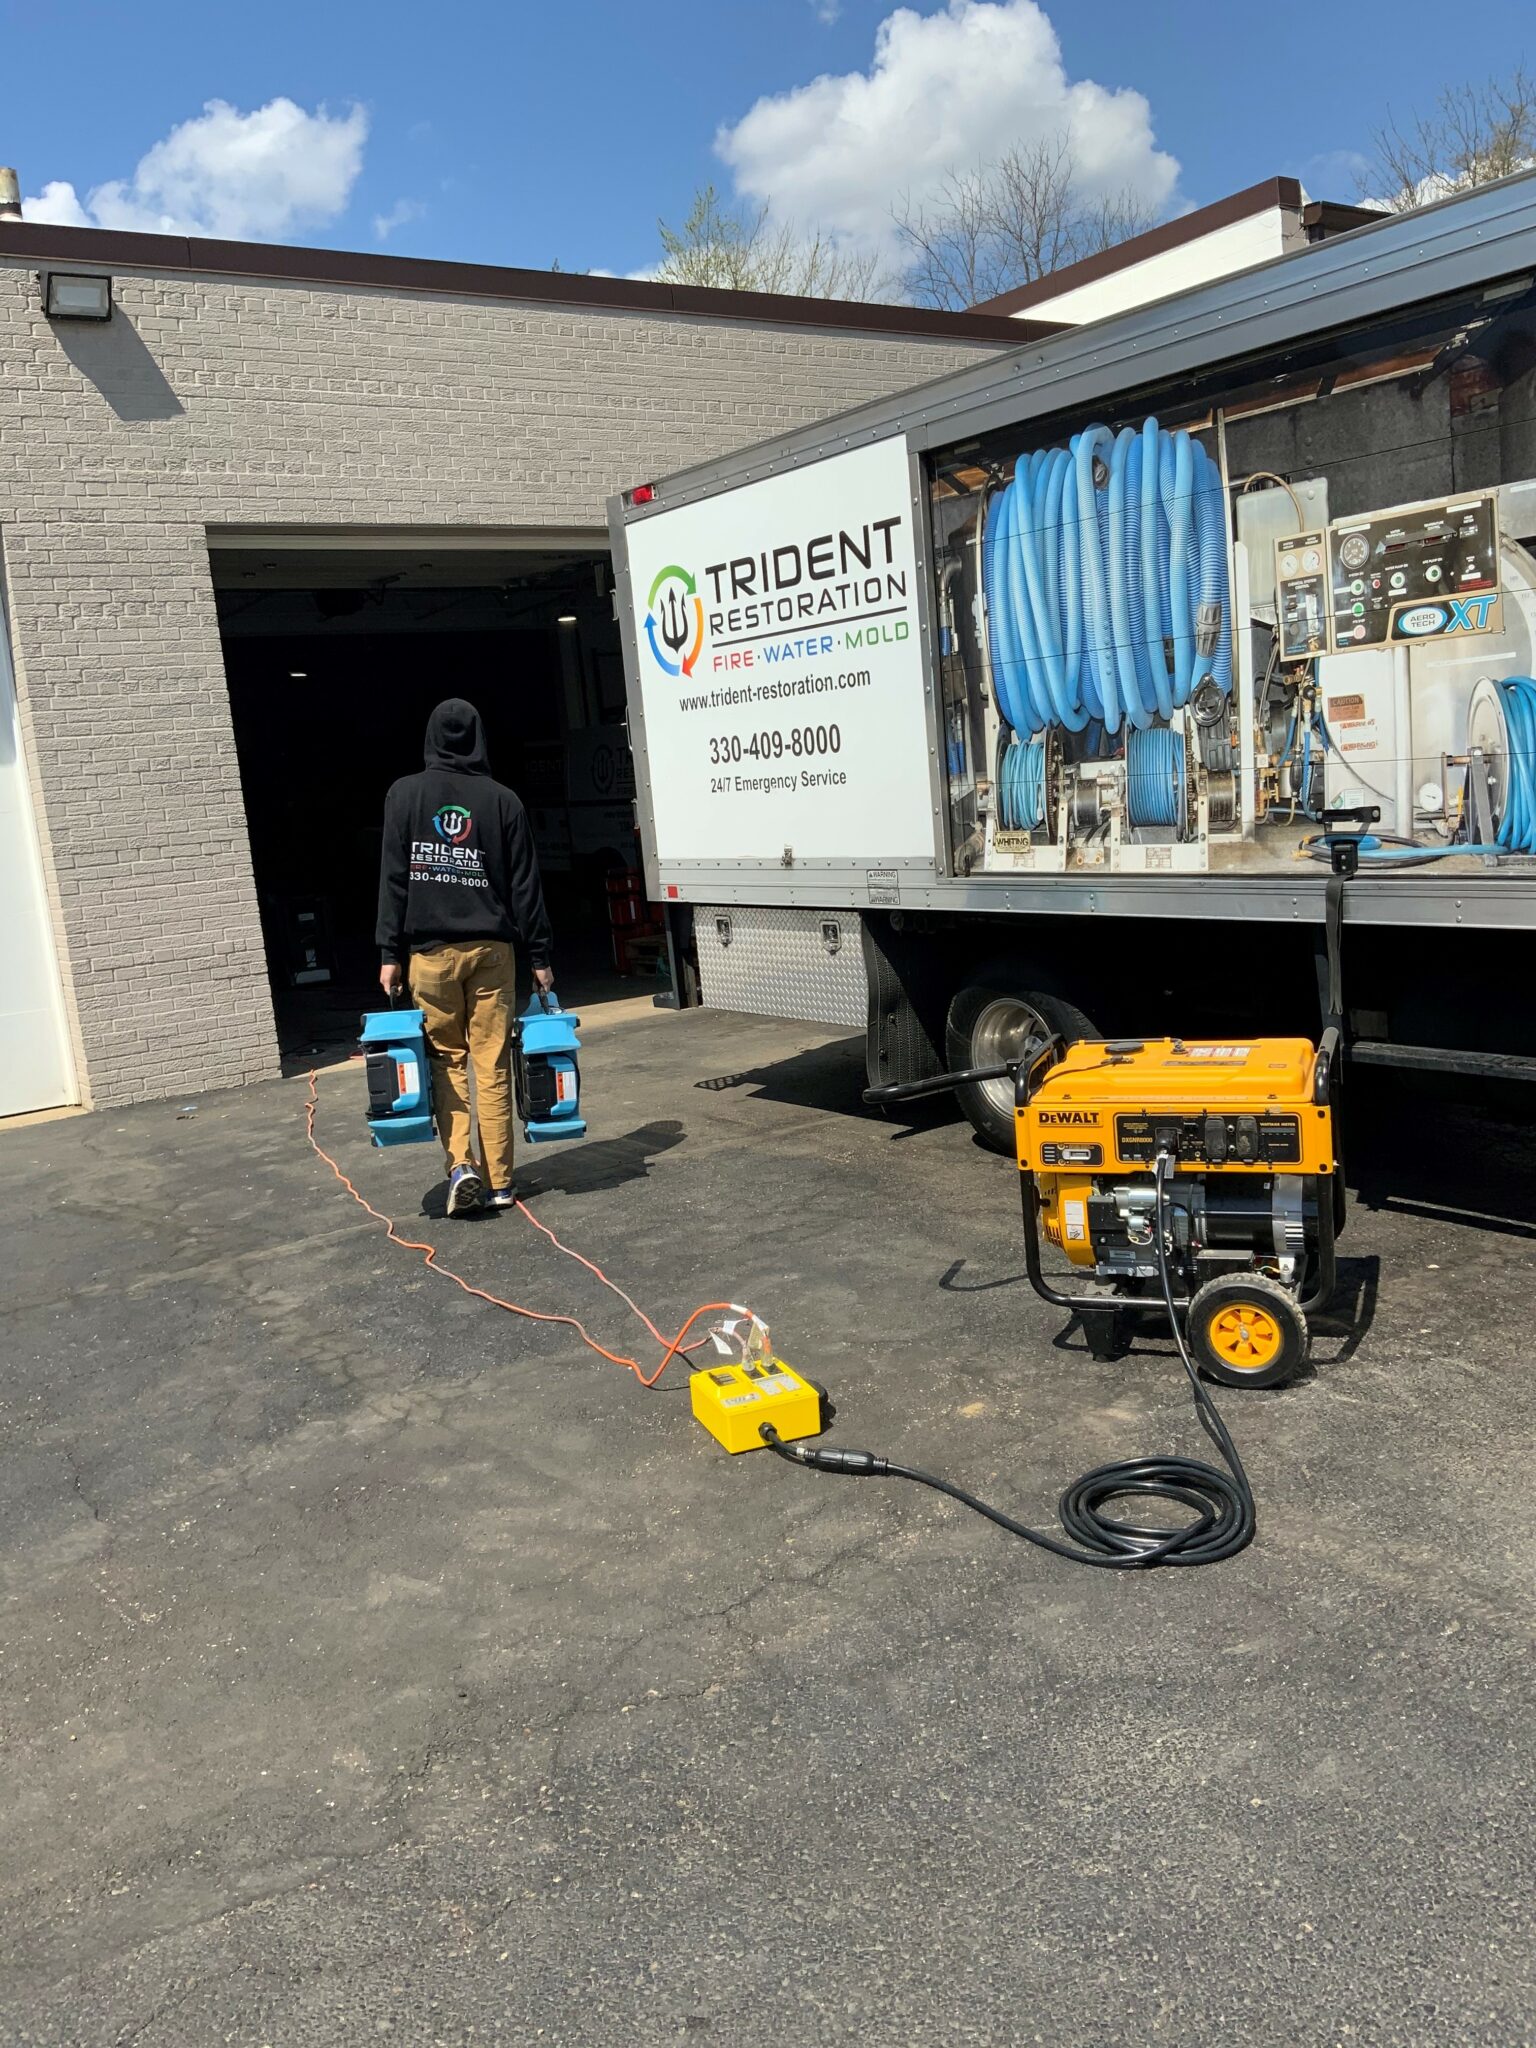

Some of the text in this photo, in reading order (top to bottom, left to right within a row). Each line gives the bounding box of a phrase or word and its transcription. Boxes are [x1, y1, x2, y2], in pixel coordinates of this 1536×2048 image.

[705, 516, 902, 604] TRIDENT
[709, 571, 906, 636] RESTORATION
[1410, 613, 1436, 622] AERO
[1444, 594, 1497, 633] XT
[1410, 619, 1436, 628] TECH
[713, 621, 909, 672] FIRE WATER MOLD
[679, 670, 871, 712] www.trident-restoration.com
[709, 724, 841, 764] 330-409-8000
[710, 769, 847, 793] 24/7 Emergency Service
[997, 837, 1029, 846] WHITING
[410, 871, 489, 887] 330-409-8000
